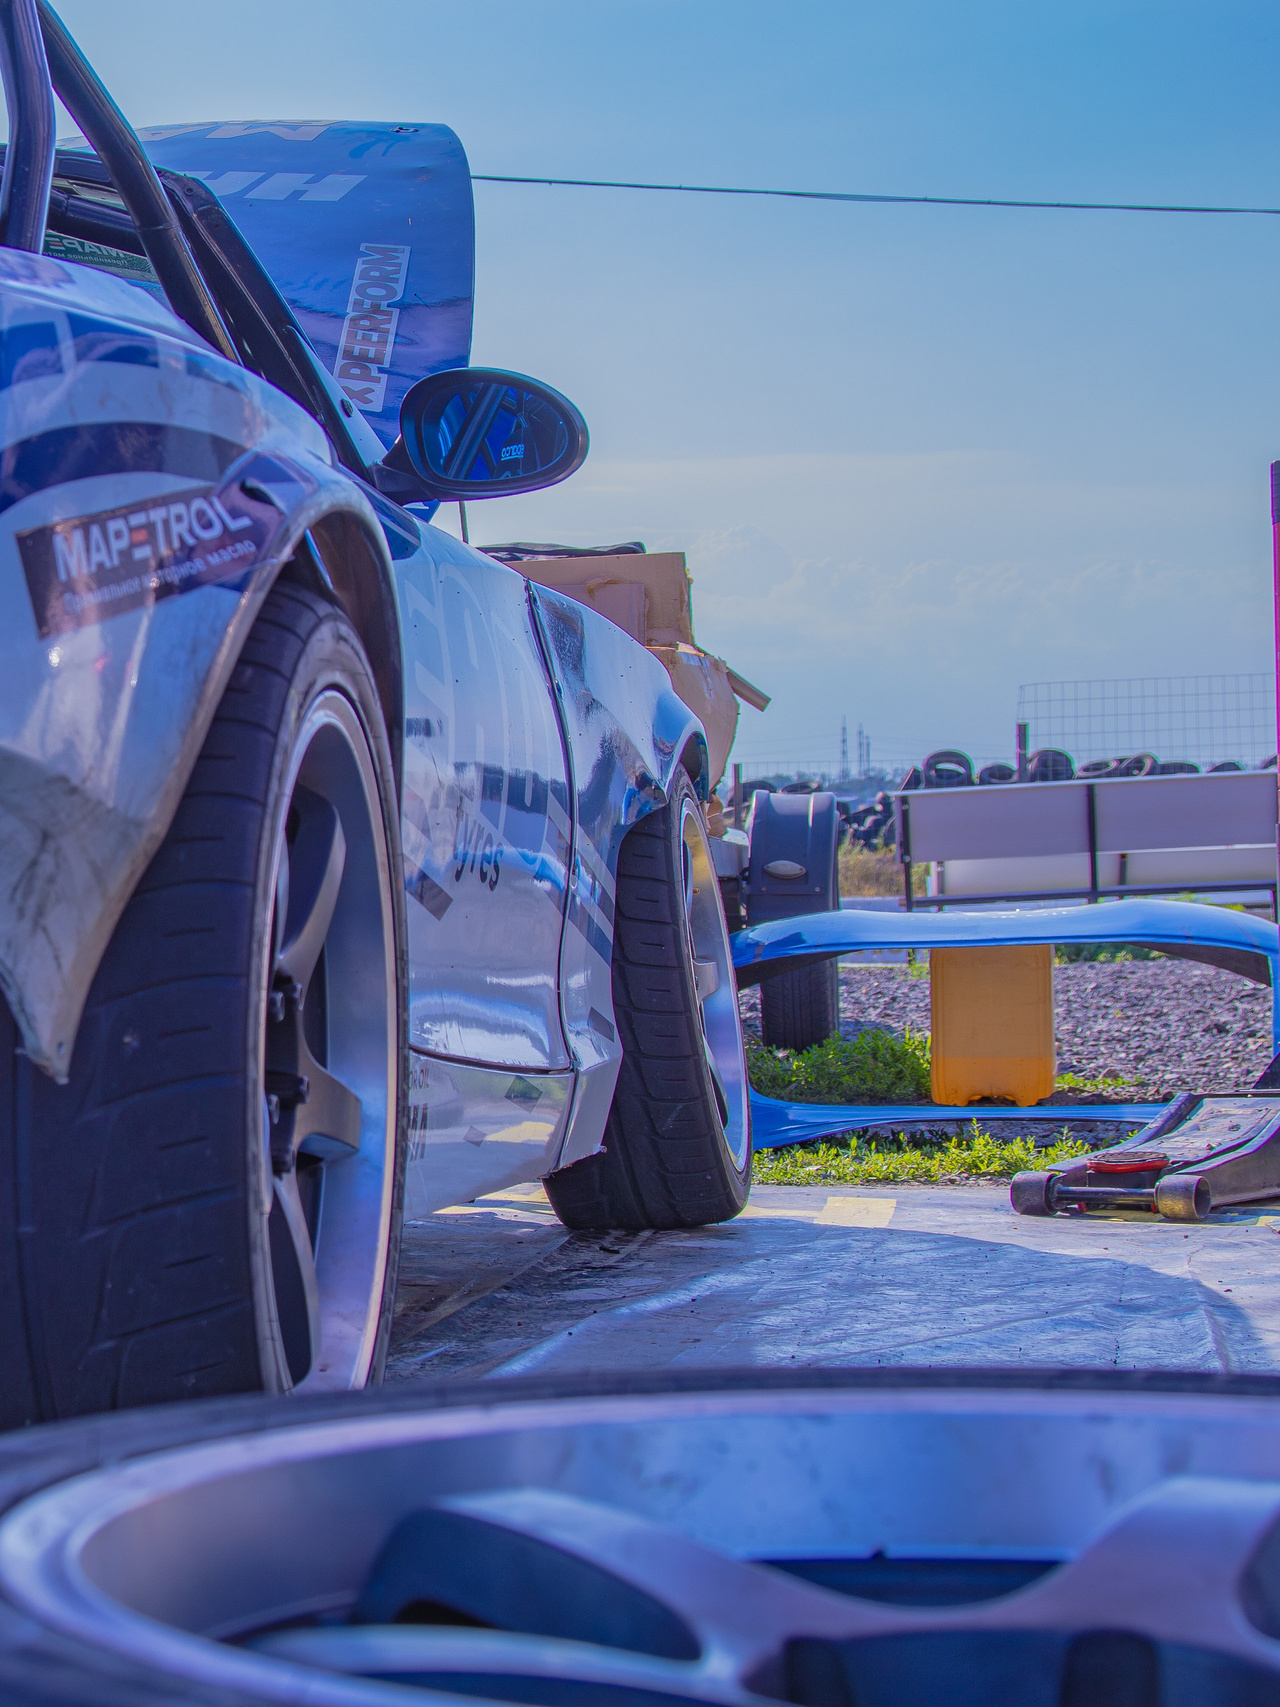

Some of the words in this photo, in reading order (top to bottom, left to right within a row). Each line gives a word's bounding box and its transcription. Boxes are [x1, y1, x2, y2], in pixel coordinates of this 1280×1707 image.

[338, 245, 405, 383] PEERFORM
[52, 496, 253, 583] MAPETROL
[205, 540, 257, 567] масло
[453, 795, 504, 891] tyres
